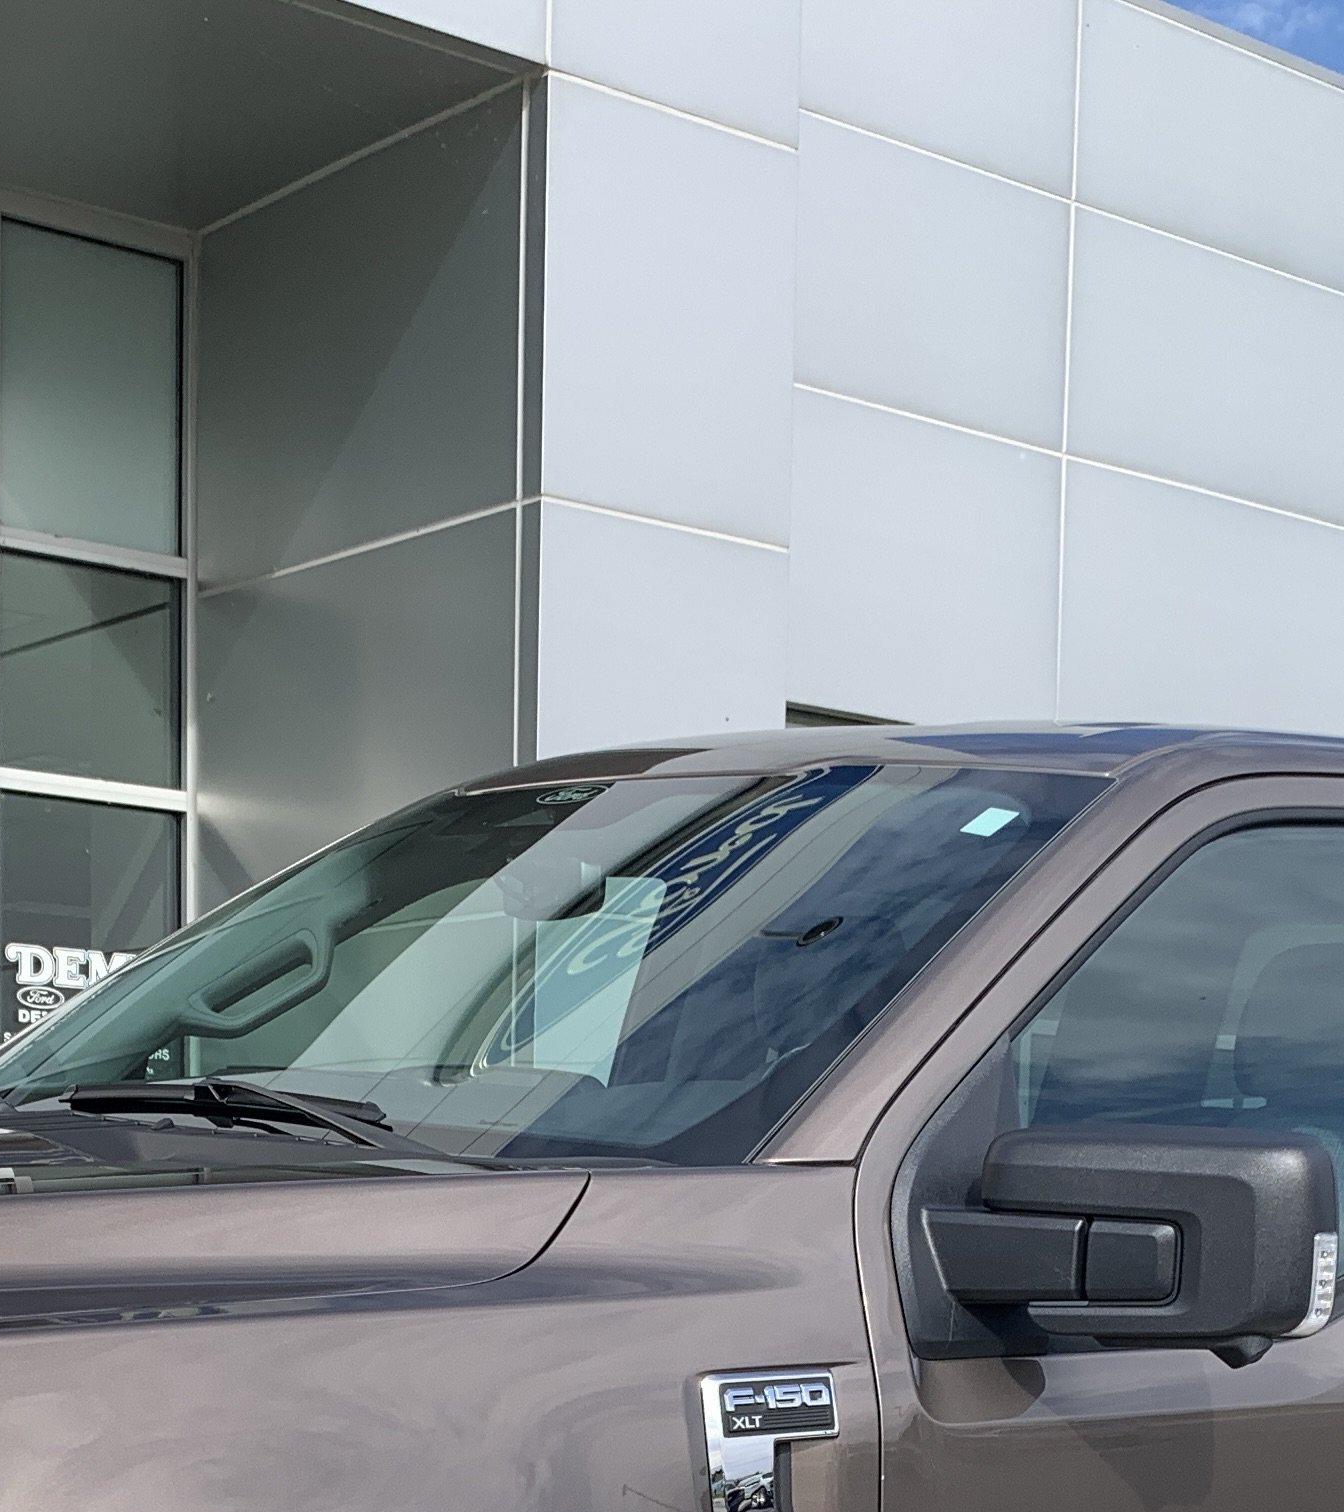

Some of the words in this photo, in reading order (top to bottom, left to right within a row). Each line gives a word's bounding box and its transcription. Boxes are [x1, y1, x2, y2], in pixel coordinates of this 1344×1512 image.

[27, 990, 55, 1004] Ford
[724, 1382, 831, 1413] F-150
[732, 1415, 763, 1430] XLT
